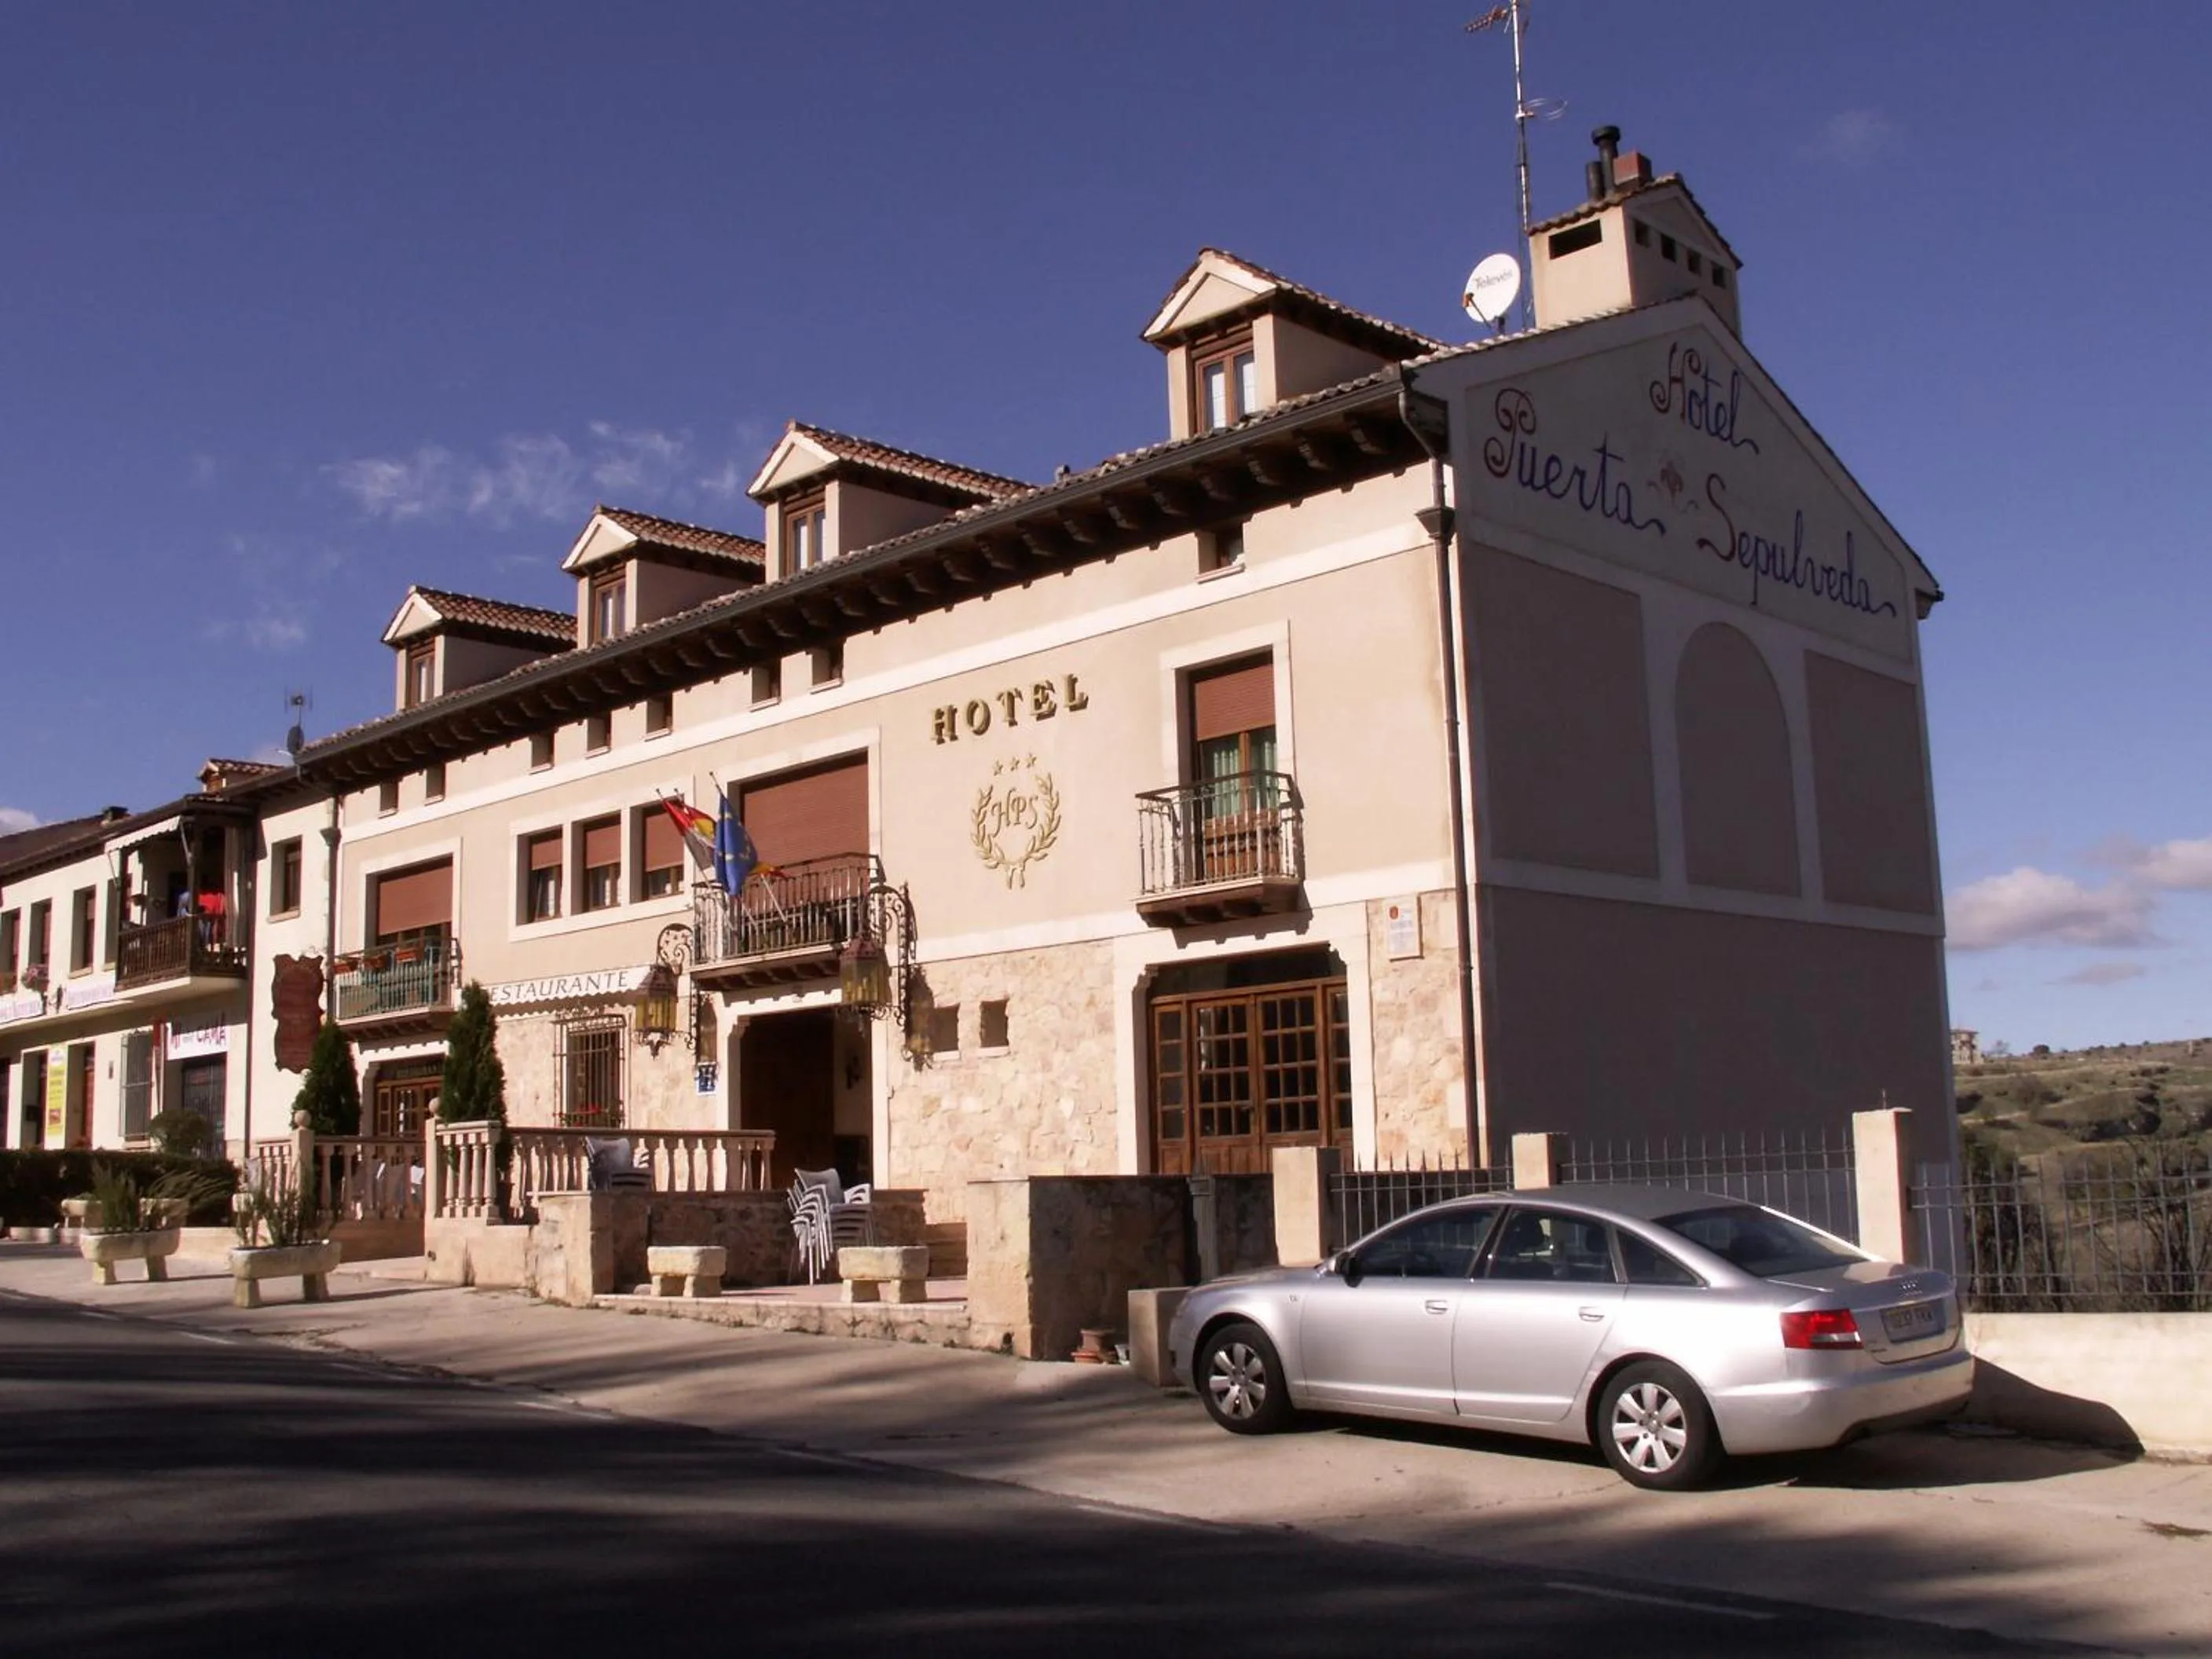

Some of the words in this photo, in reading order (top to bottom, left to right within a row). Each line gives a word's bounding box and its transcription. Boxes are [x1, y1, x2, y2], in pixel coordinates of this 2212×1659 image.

[1650, 342, 1759, 454] Hotel
[1484, 387, 1666, 536] Puerta
[1697, 474, 1896, 617] Sepulveda
[932, 673, 1089, 745] HOTEL
[991, 787, 1038, 838] HPS
[489, 971, 629, 1002] ESTAURANTE
